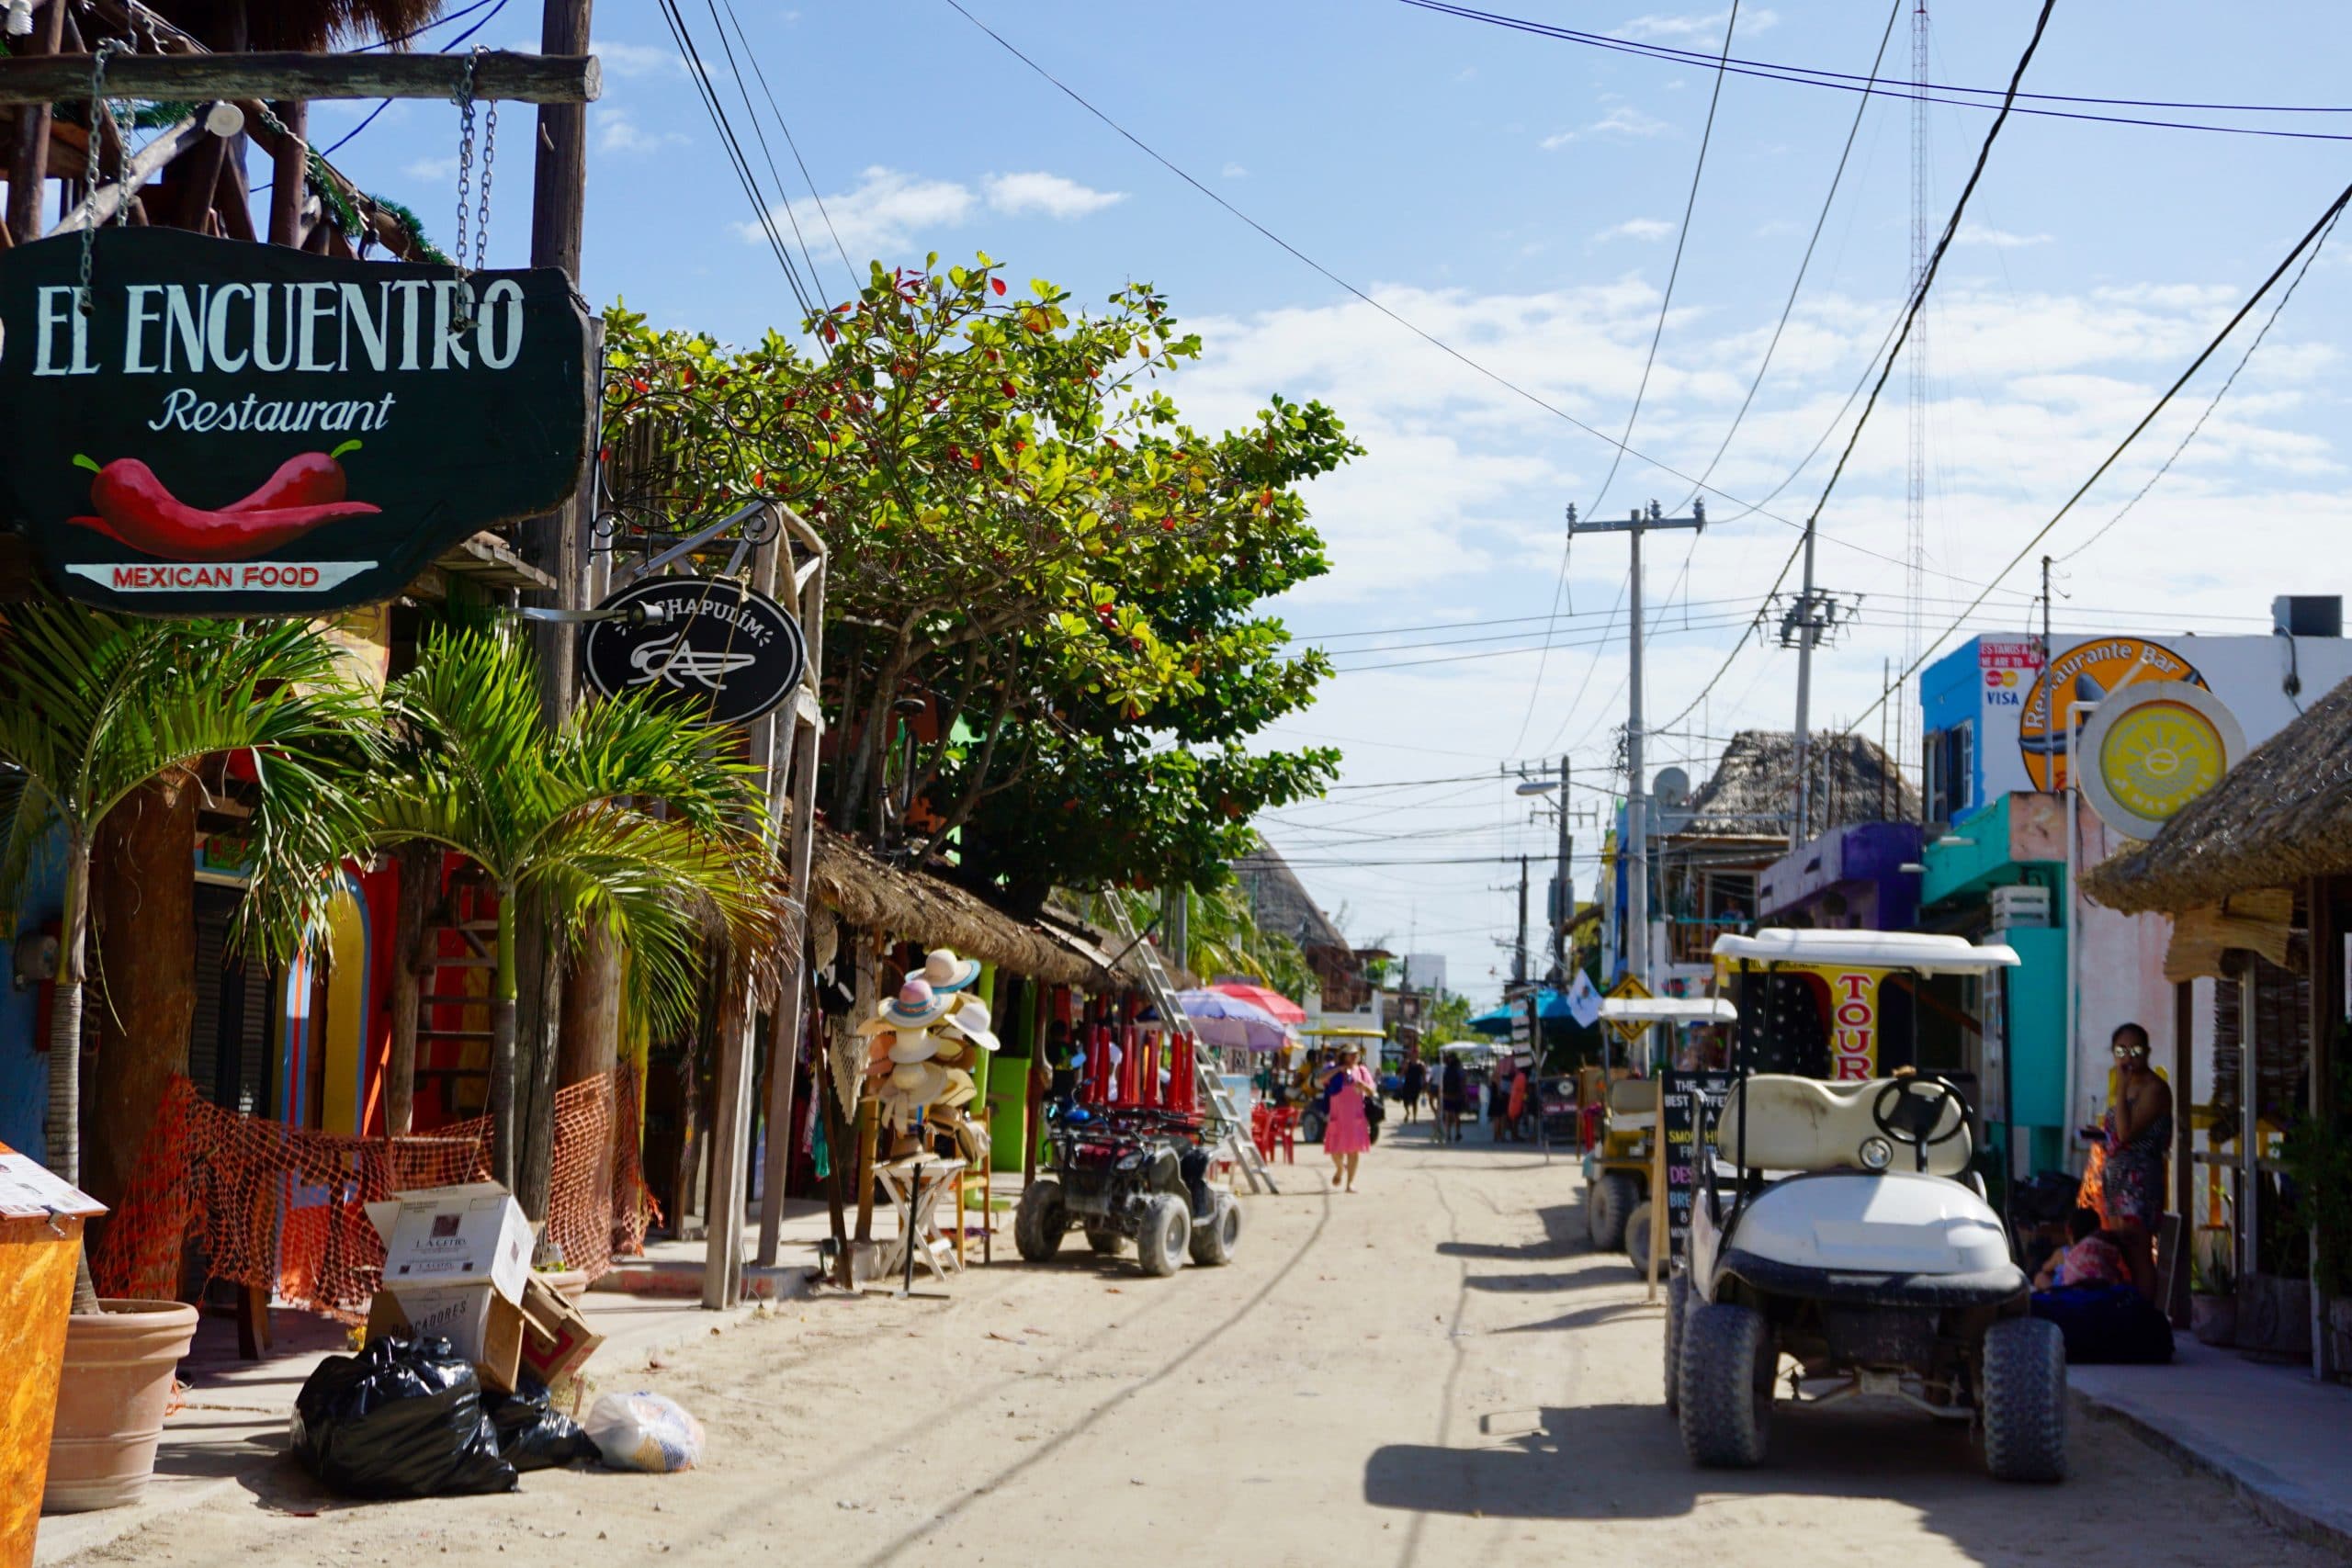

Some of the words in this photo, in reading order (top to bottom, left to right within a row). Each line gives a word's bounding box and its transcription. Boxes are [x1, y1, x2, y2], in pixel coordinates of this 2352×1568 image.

[32, 286, 102, 377] EL
[123, 279, 525, 375] ENCUENTRO
[148, 387, 397, 433] Restaurant
[112, 565, 234, 589] MEXICAN
[243, 564, 321, 589] FOOD
[2142, 645, 2179, 673] Bar
[1986, 692, 2019, 705] VISA
[1836, 974, 1873, 1081] TOUR
[1675, 1079, 1698, 1093] THE
[1665, 1094, 1690, 1108] BEST
